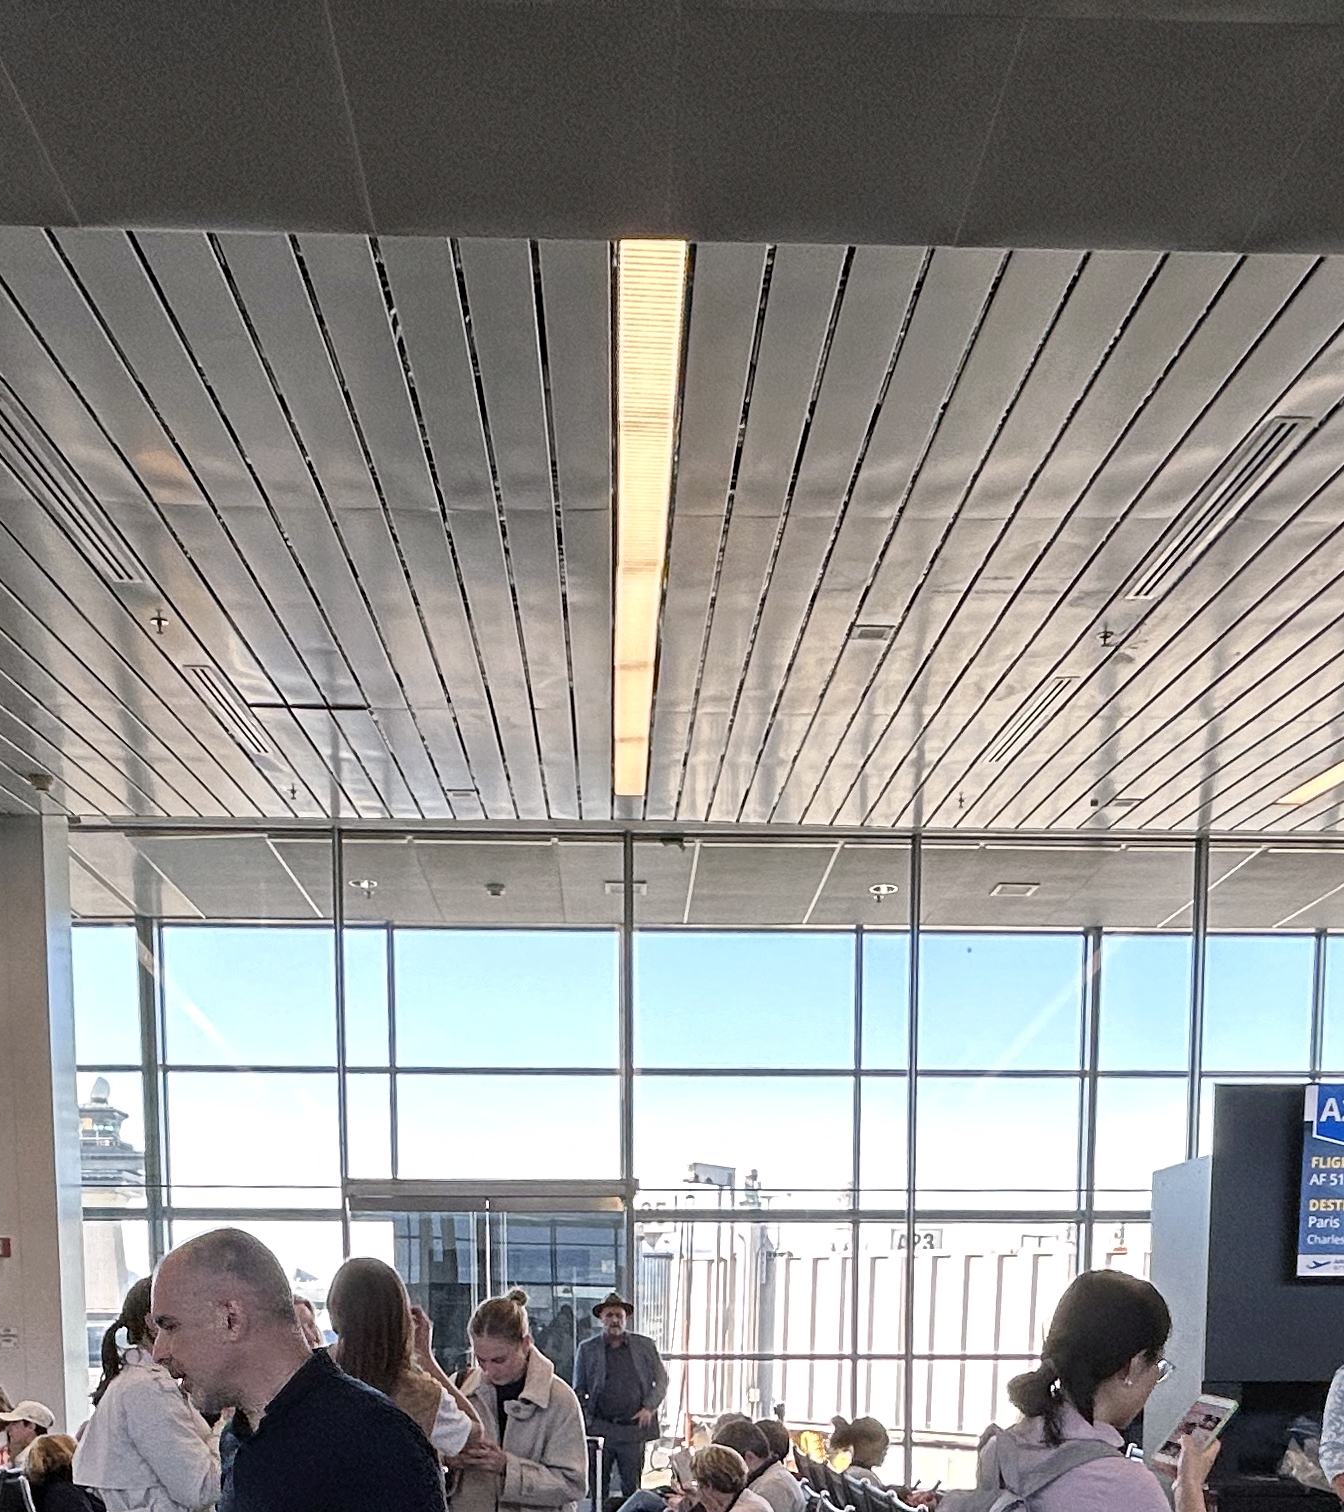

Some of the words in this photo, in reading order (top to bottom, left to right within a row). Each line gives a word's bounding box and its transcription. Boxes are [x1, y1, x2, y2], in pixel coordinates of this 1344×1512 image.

[1309, 1173, 1326, 1186] AF
[1329, 1173, 1344, 1186] 51
[1308, 1216, 1341, 1229] Paris
